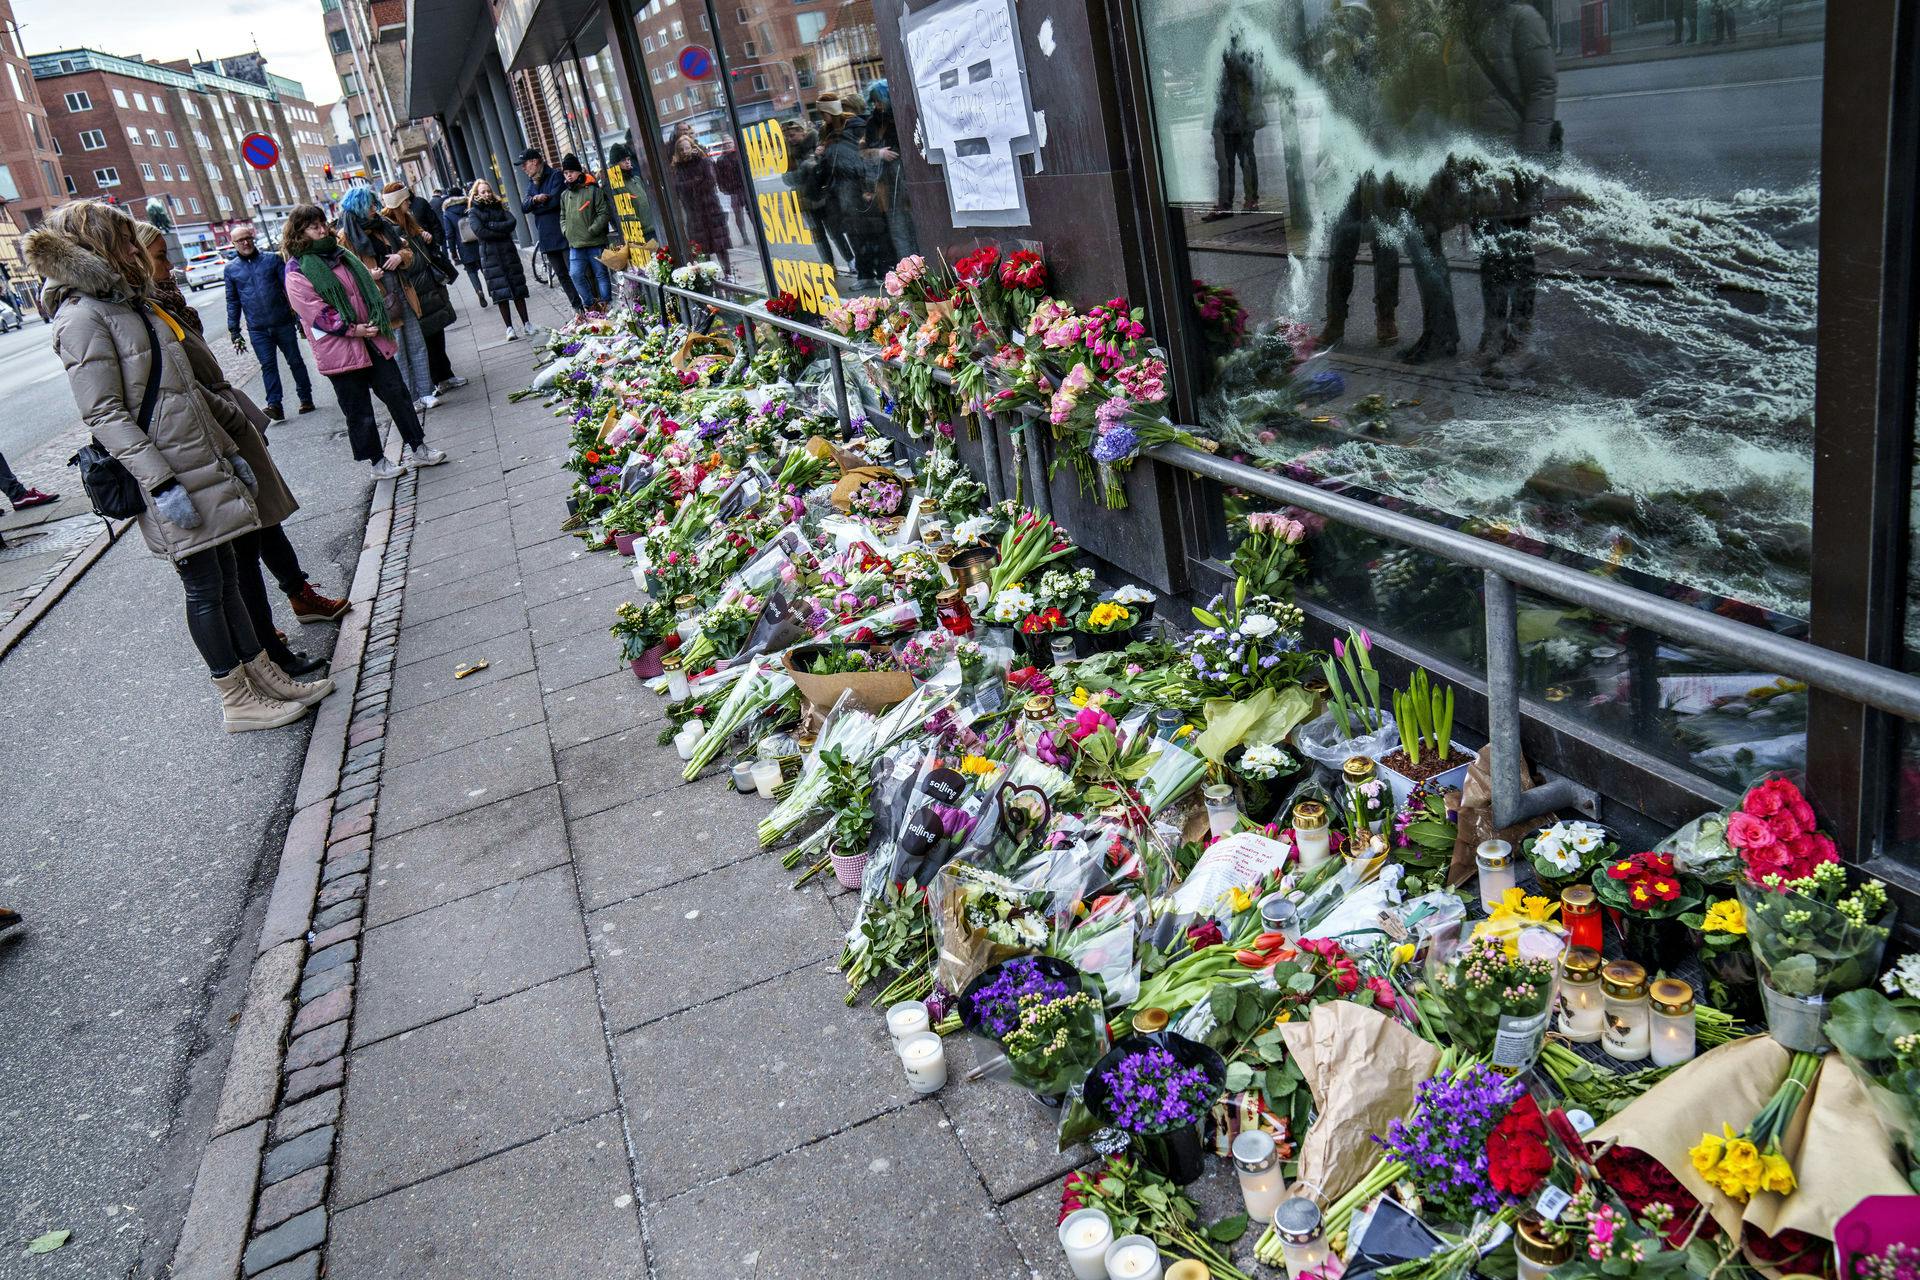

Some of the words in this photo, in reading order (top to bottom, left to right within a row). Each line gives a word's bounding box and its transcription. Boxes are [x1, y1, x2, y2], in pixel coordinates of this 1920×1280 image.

[942, 28, 966, 64] OG
[991, 67, 1017, 124] PÅ
[742, 118, 789, 177] MAD
[757, 190, 813, 246] SKAL
[772, 258, 841, 316] SPISES
[929, 780, 957, 800] salling
[908, 822, 936, 843] salling
